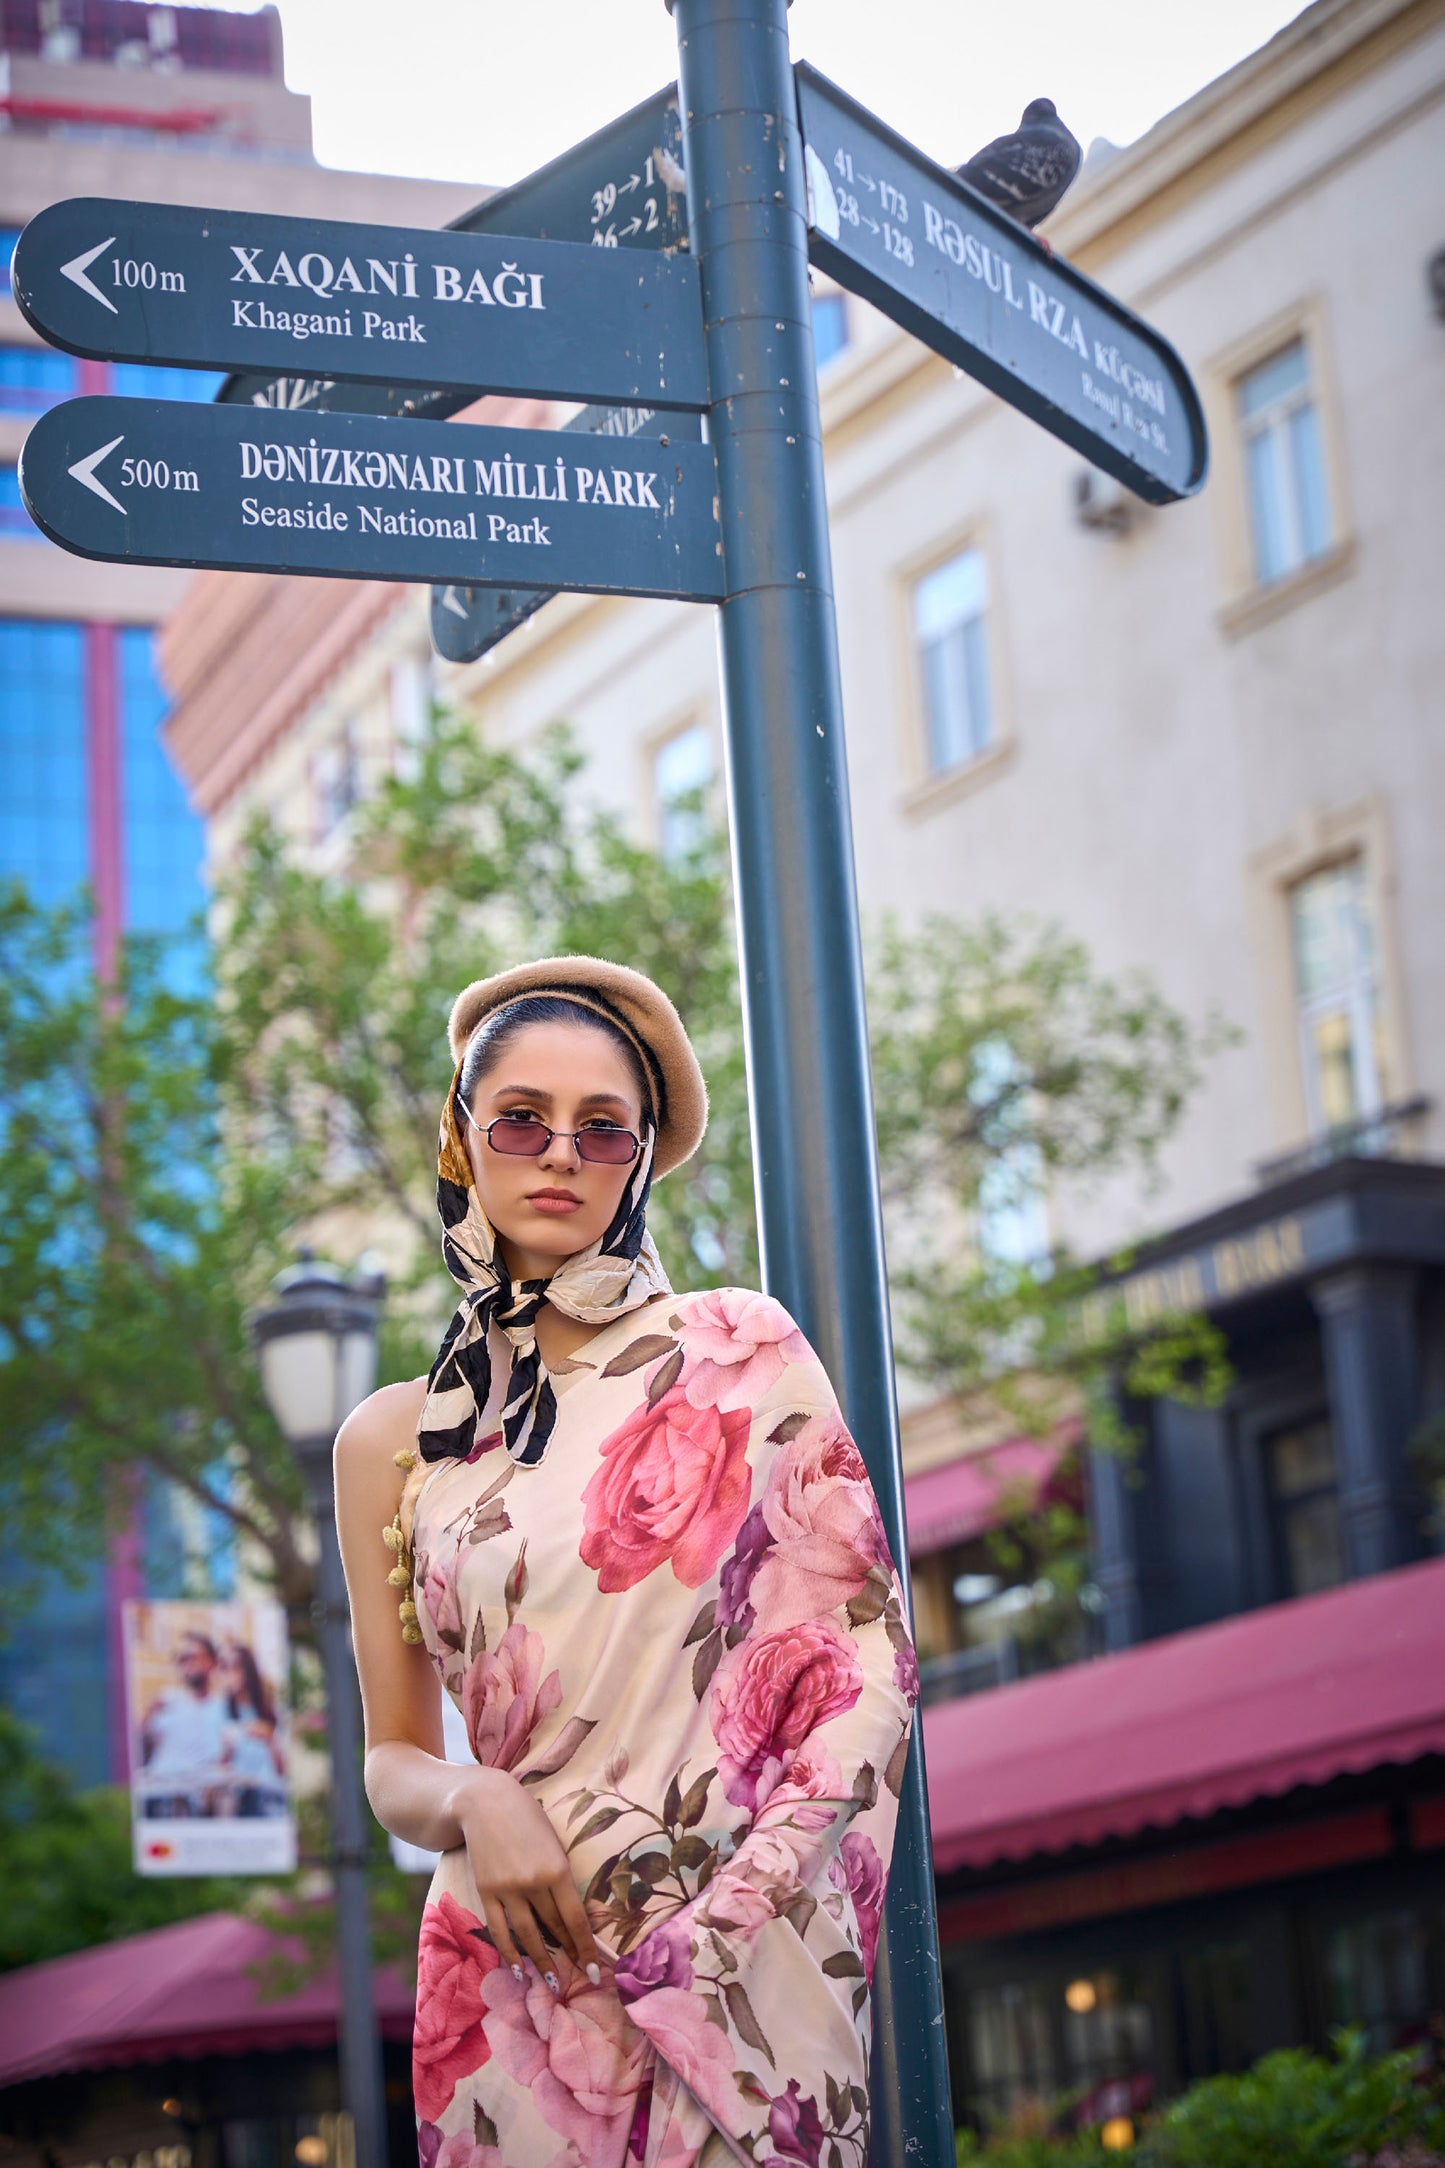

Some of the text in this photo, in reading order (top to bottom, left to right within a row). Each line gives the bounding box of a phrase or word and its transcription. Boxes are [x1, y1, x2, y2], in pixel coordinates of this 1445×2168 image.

[643, 197, 660, 232] 2
[834, 147, 909, 224] 41 173
[836, 187, 914, 268] 28 128
[229, 245, 546, 310] XAQANİ BAĞI
[922, 200, 1024, 310] RƏSUL
[1027, 279, 1090, 361] RZA
[232, 299, 428, 343] Khagani Park
[239, 437, 661, 508] DƏNİZKƏNARI MİLLİ PARK
[241, 497, 553, 546] Seaside National Park
